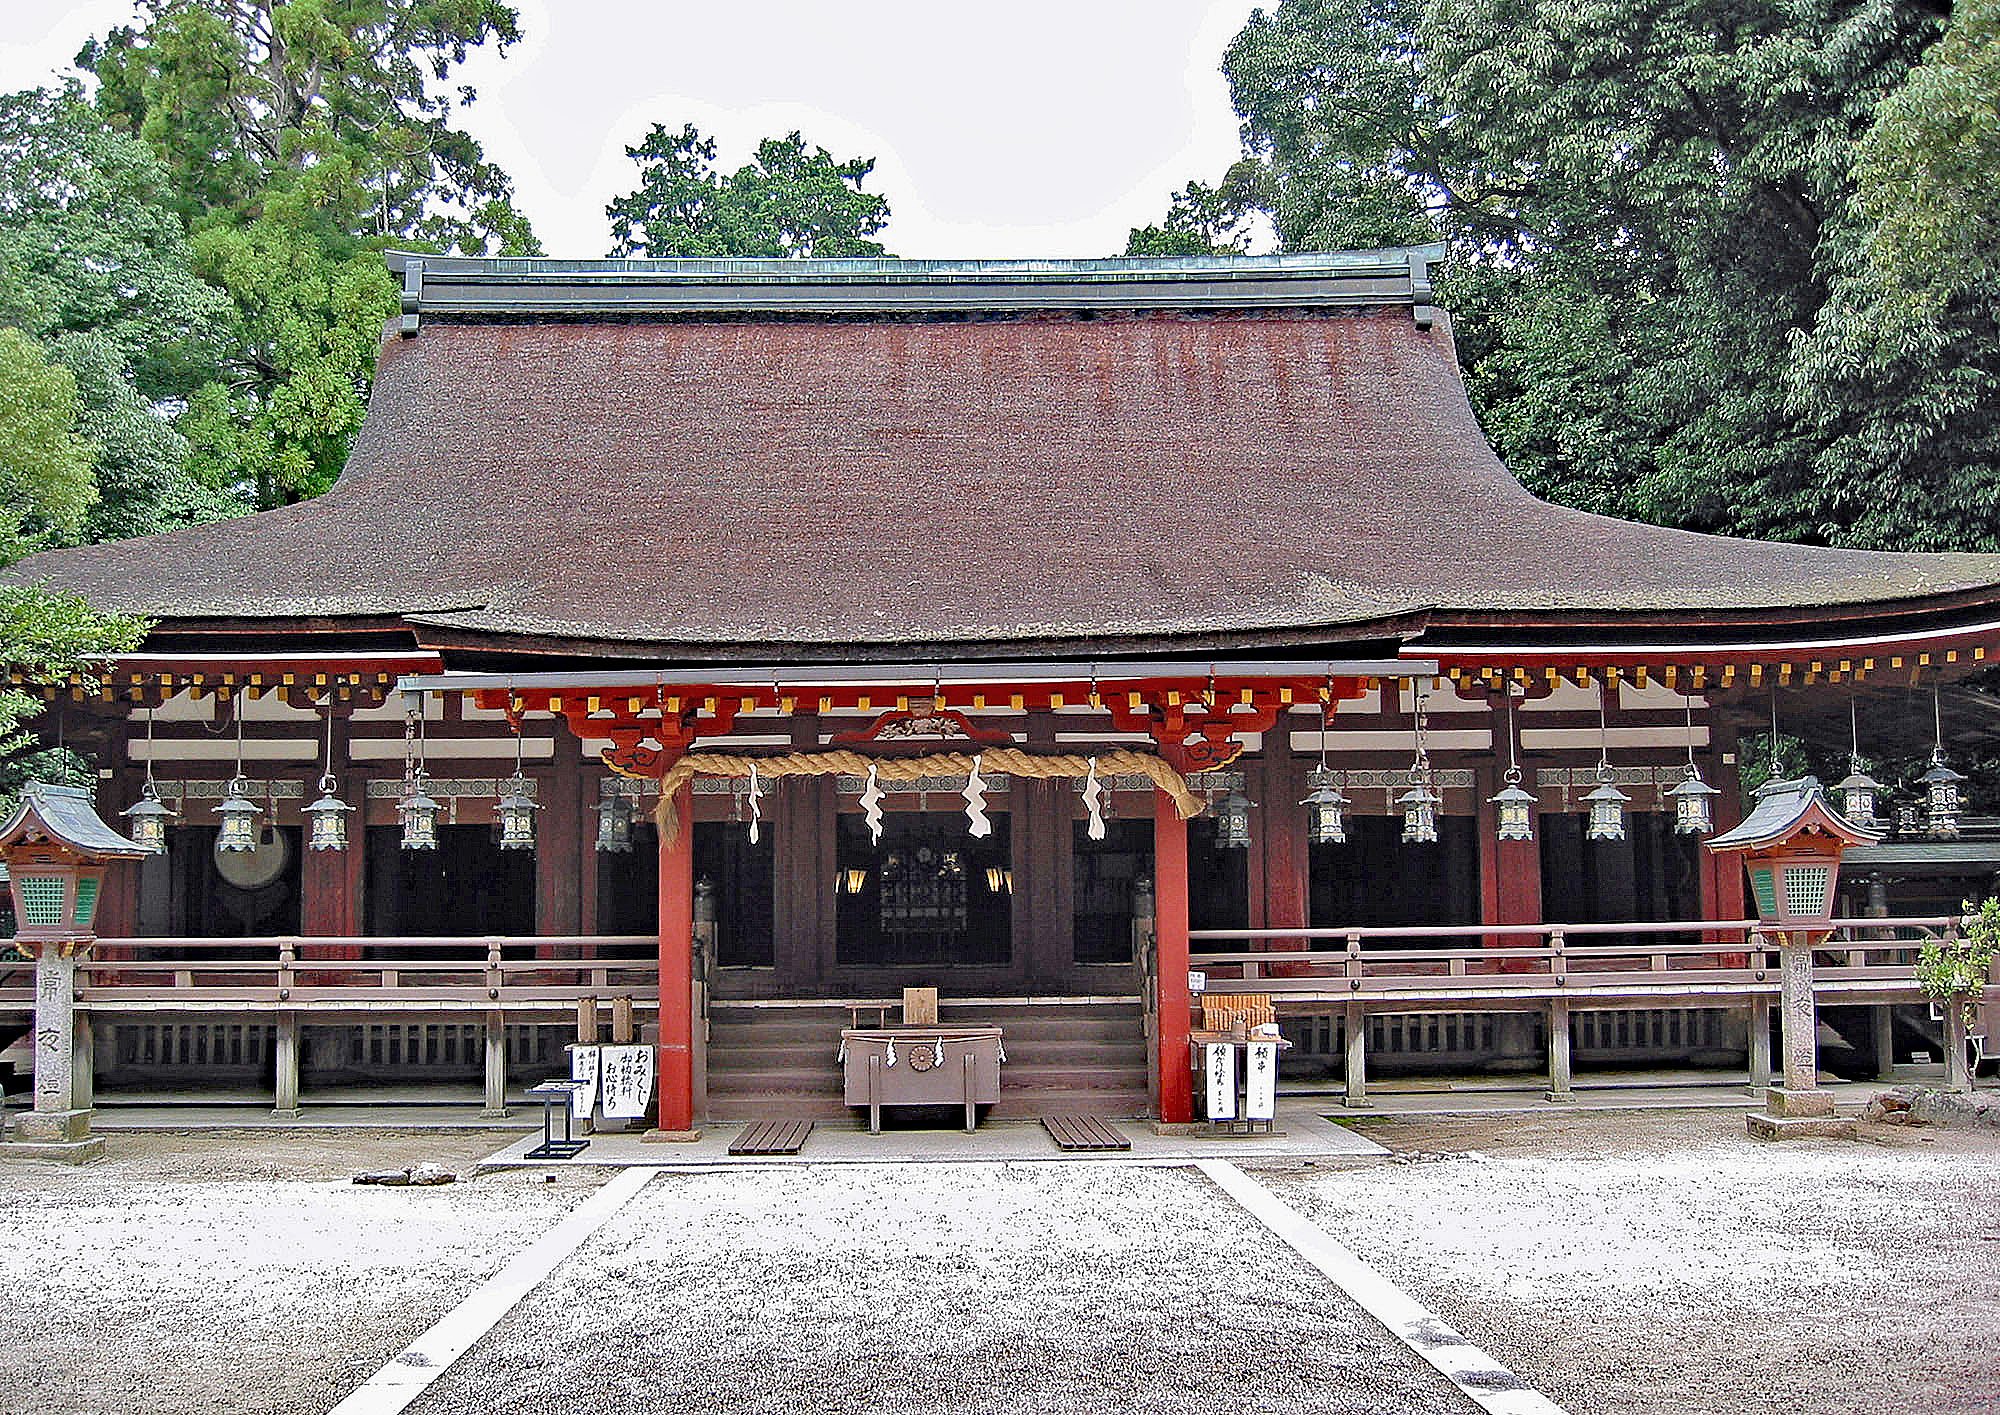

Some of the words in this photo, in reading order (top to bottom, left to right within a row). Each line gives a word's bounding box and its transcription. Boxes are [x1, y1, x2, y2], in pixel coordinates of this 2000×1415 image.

[605, 1062, 618, 1111] お心持ち
[633, 1049, 649, 1106] おみくじ
